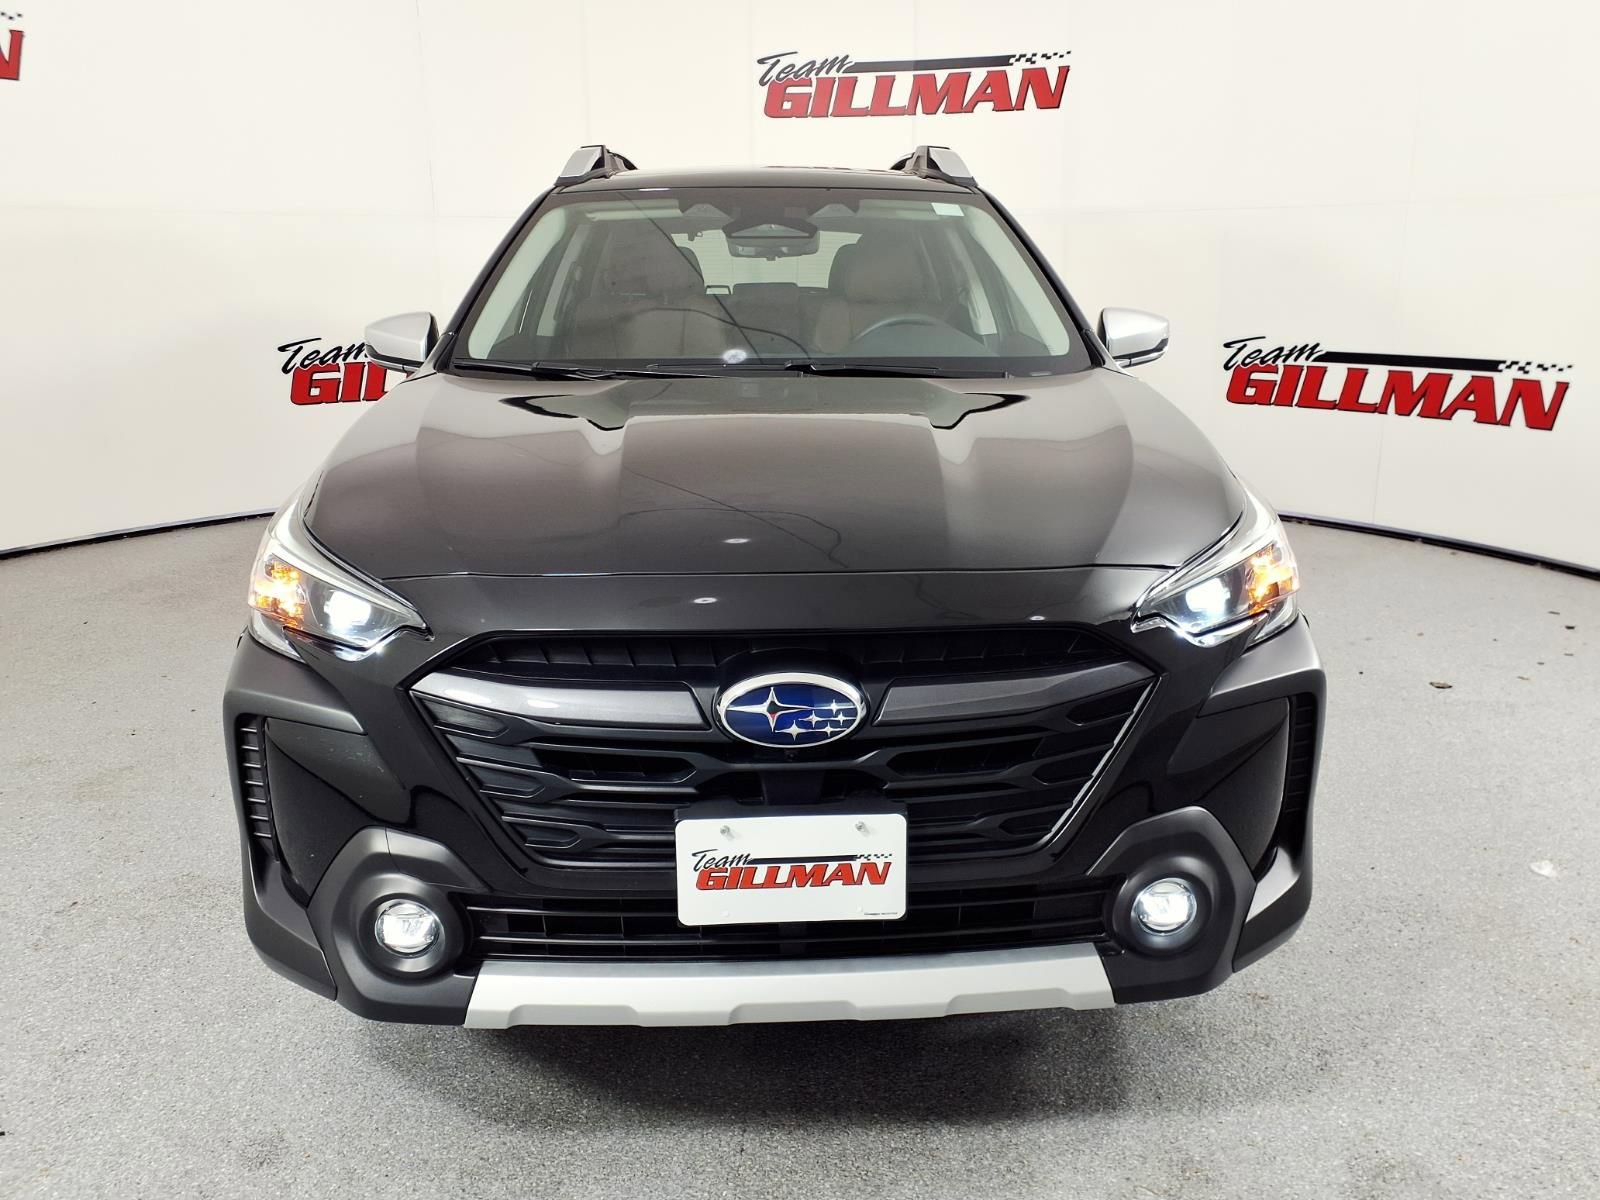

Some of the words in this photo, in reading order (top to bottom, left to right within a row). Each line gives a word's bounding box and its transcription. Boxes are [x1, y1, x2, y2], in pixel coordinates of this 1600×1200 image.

[756, 51, 854, 87] Team
[763, 65, 1070, 118] GILLMAN
[1223, 336, 1323, 371] Team
[1226, 364, 1570, 431] GILLMAN
[691, 849, 752, 872] Team
[696, 862, 892, 891] GILLMAN
